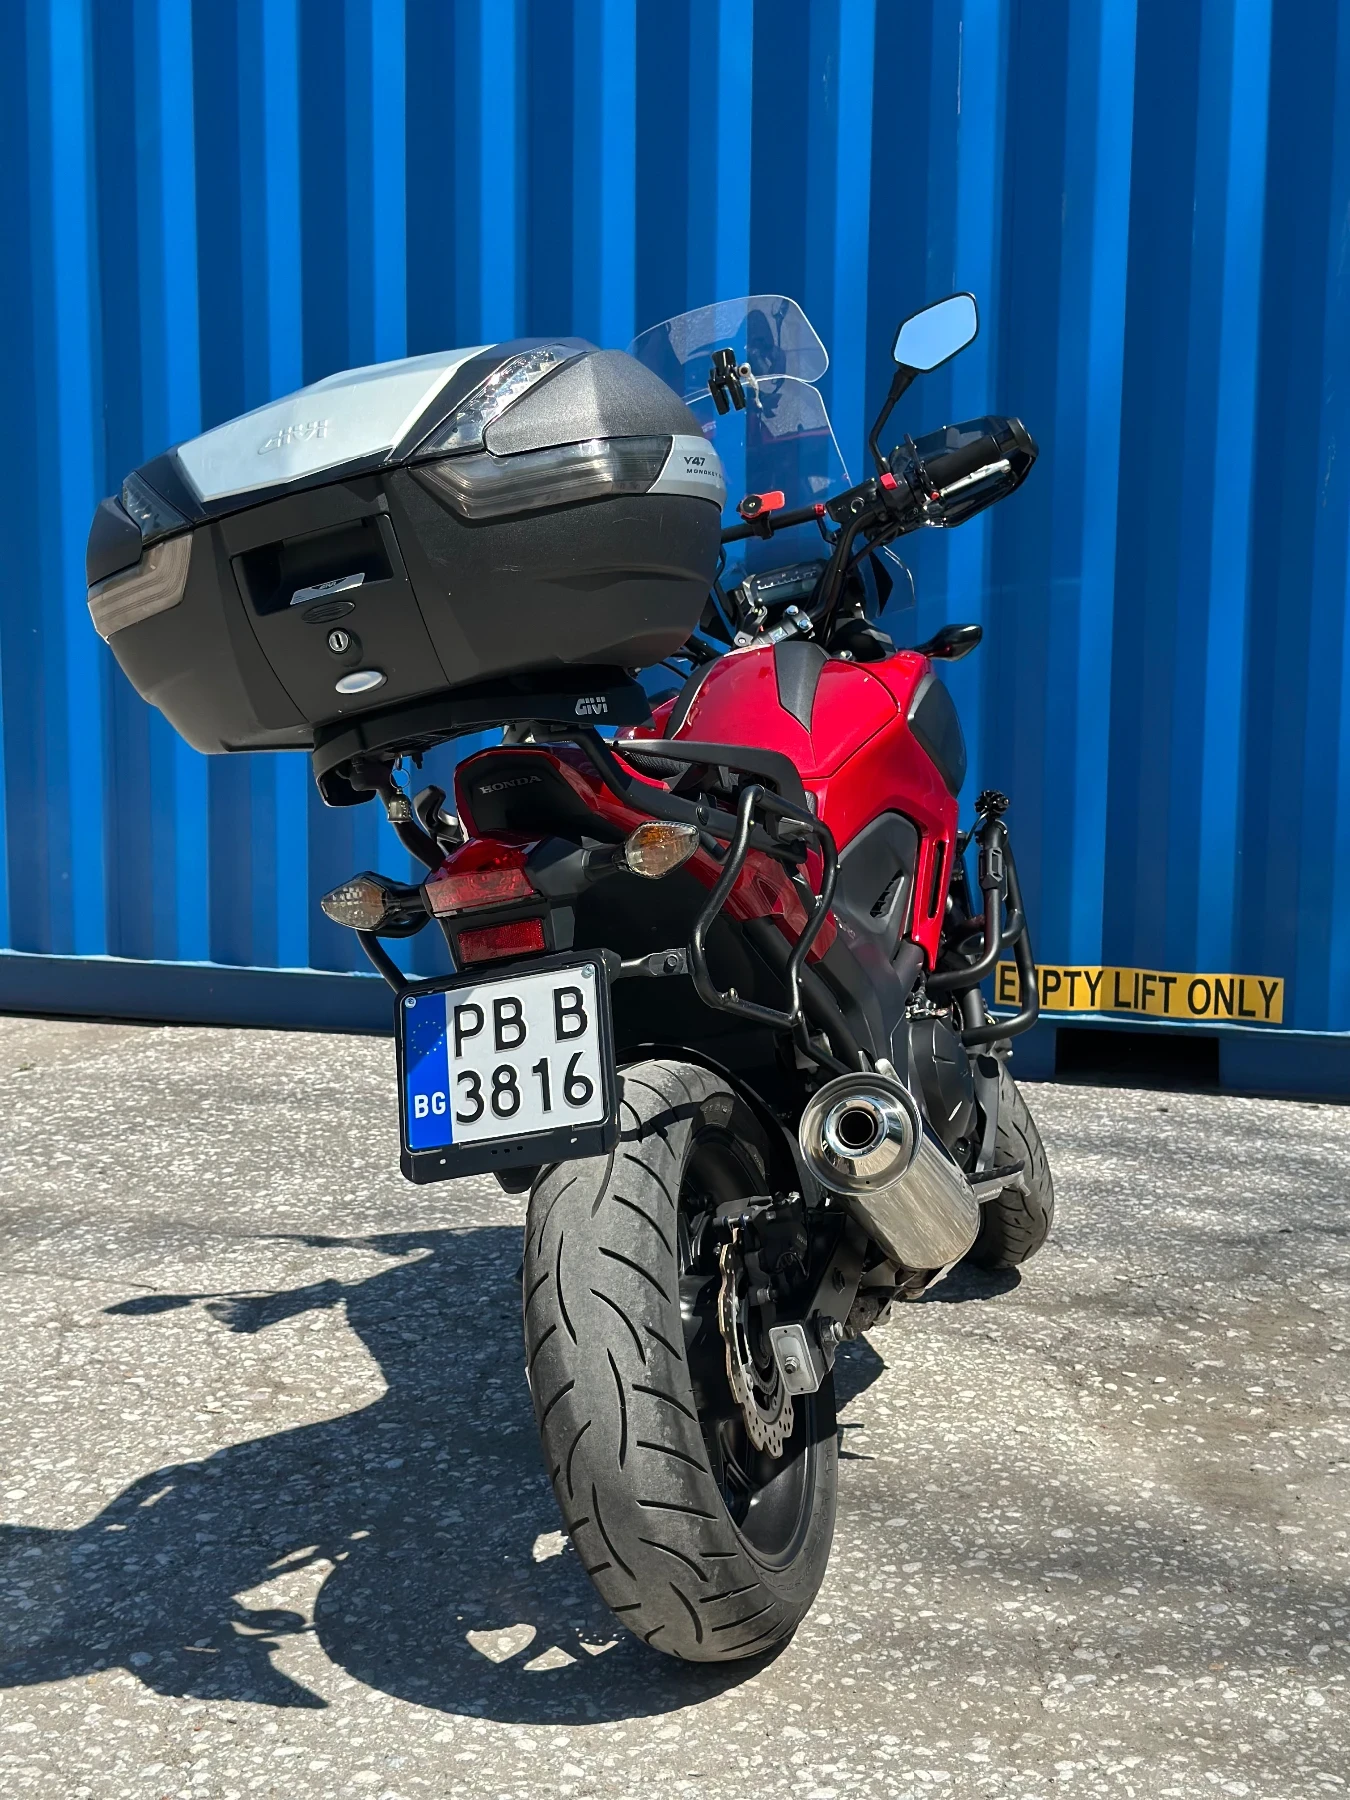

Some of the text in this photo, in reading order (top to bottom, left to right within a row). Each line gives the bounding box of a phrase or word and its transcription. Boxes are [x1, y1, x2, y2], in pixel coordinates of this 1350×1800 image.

[684, 456, 706, 466] V47
[686, 468, 718, 477] MONOKEY
[575, 696, 608, 715] GIVI
[480, 775, 542, 794] HONDA
[1000, 965, 1279, 1018] EPTY LIFT ONLY
[454, 986, 588, 1058] PB B
[456, 1051, 594, 1123] 3816
[414, 1091, 446, 1119] BG
